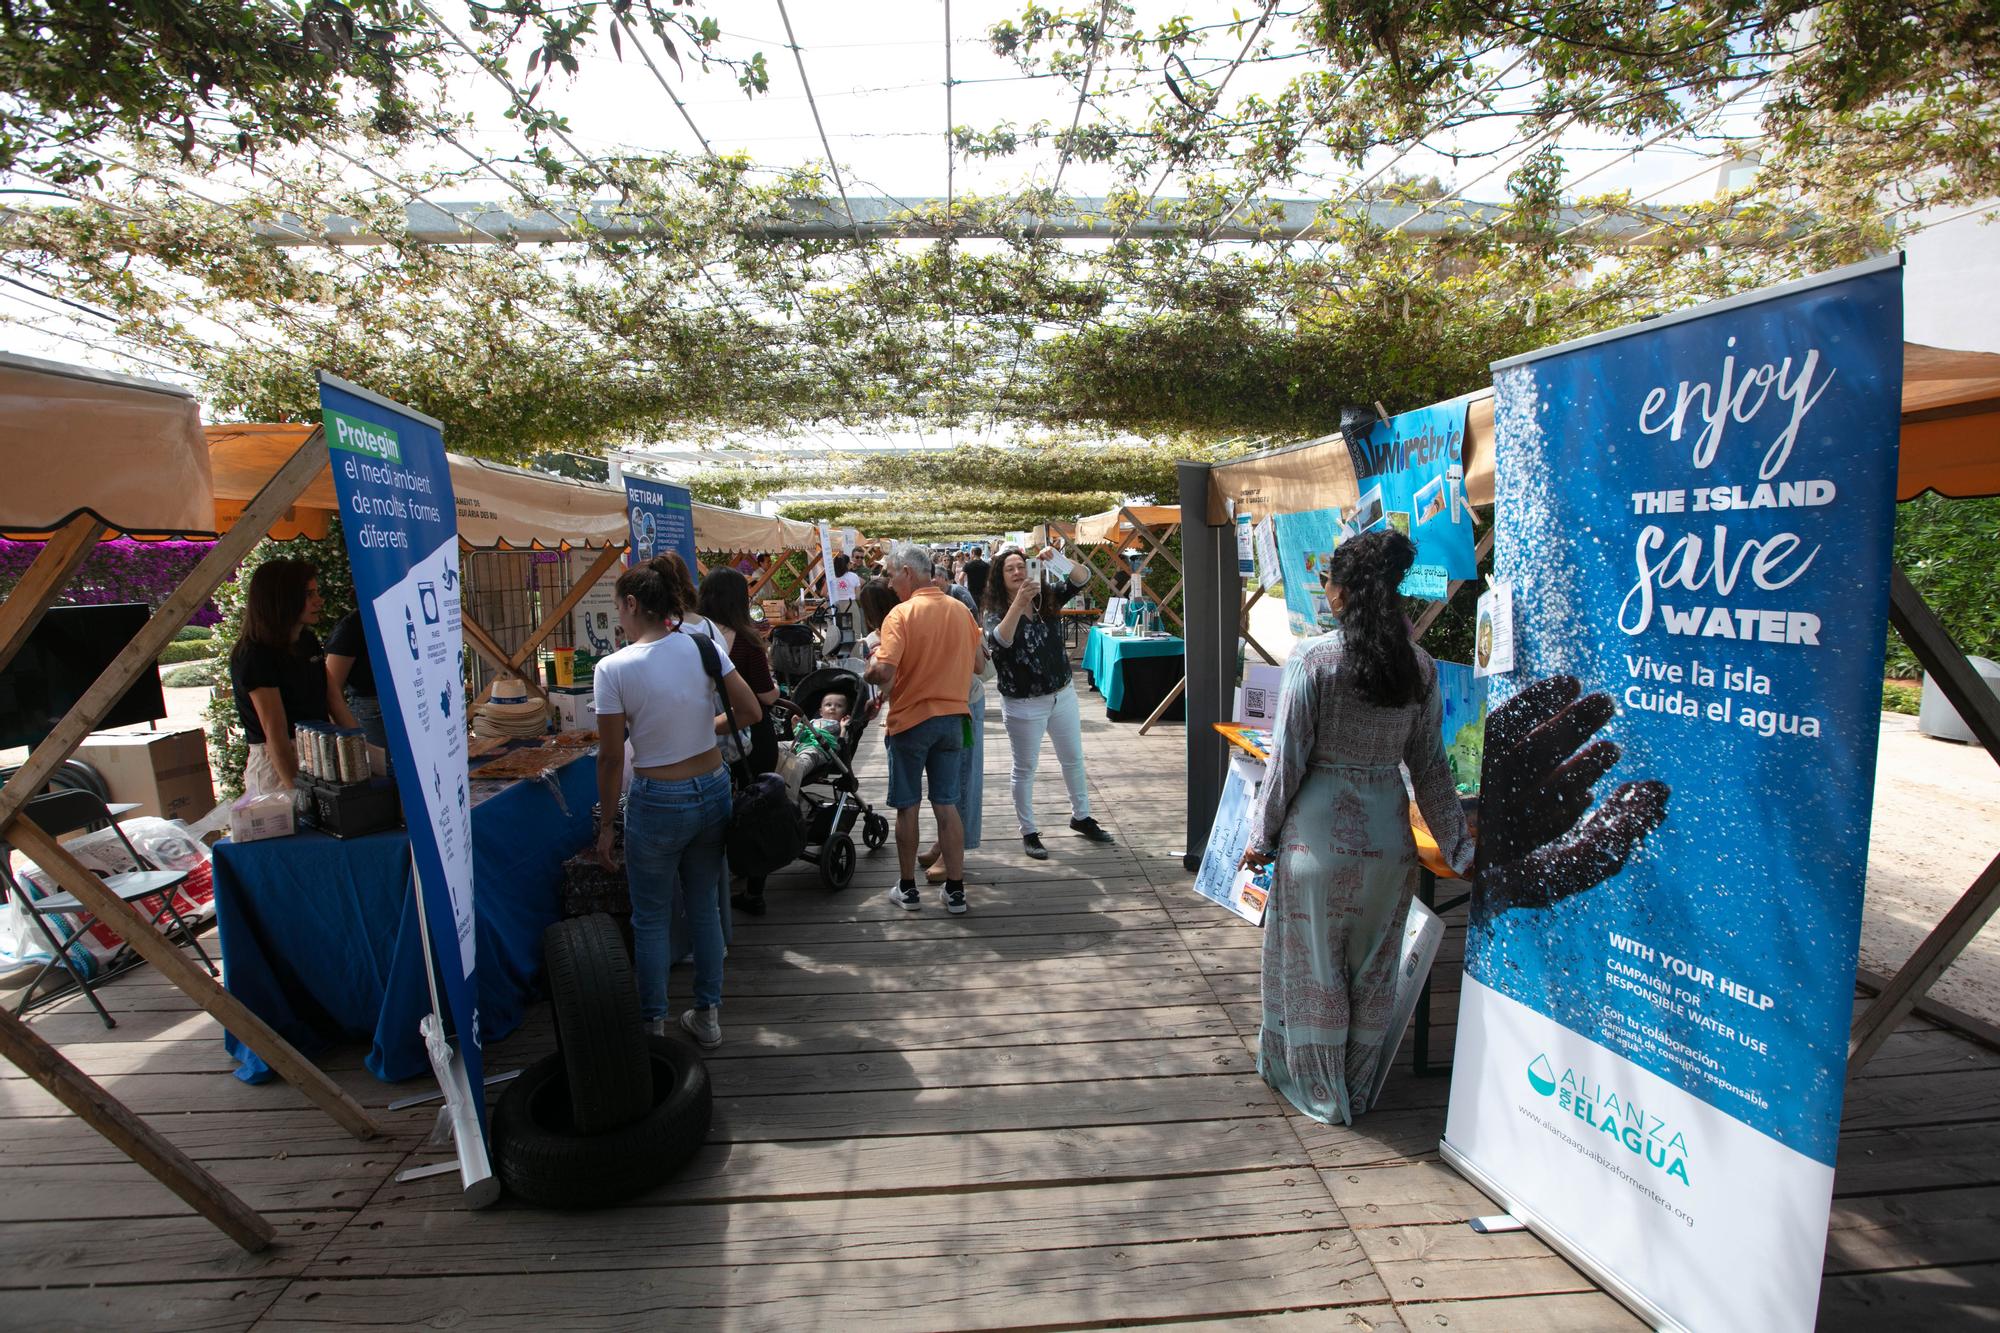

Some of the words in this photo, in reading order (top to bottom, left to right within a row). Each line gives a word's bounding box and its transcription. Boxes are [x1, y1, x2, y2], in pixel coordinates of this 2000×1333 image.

[1638, 337, 1837, 480] enjoy
[335, 417, 399, 459] Protegim
[345, 456, 359, 480] el
[352, 490, 371, 514] de
[372, 495, 407, 519] moltes
[408, 498, 440, 522] formes
[628, 488, 664, 507] RETIRAM
[1631, 489, 1685, 515] THE
[1692, 479, 1836, 512] ISLAND
[360, 524, 408, 549] diferents
[1660, 605, 1822, 646] WATER
[1626, 655, 1683, 683] Vive
[1691, 660, 1715, 687] la
[1723, 665, 1770, 695] isla
[1624, 686, 1698, 717] Cuida
[1707, 697, 1731, 722] el
[1739, 708, 1820, 738] agua
[1607, 958, 1671, 995] CAMPAIGN
[1675, 987, 1700, 1007] FOR
[1609, 931, 1655, 962] WITH
[1659, 952, 1714, 989] YOUR
[1719, 977, 1774, 1011] HELP
[1605, 972, 1684, 1016] RESPONSIBLE
[1688, 1010, 1735, 1040] WATER
[1739, 1031, 1768, 1056] USE
[1601, 1028, 1615, 1040] del
[1616, 1035, 1639, 1053] agua
[1603, 1005, 1624, 1022] Con
[1627, 1016, 1639, 1030] tu
[1641, 1026, 1719, 1071] colaboración
[1602, 1018, 1642, 1044] Campaña
[1644, 1040, 1656, 1051] de
[1658, 1048, 1701, 1074] consumo
[1704, 1071, 1768, 1110] responsable
[1559, 1087, 1572, 1111] POR
[1561, 1068, 1688, 1158] ALIANZA
[1518, 1105, 1694, 1228] www.alianzaaguaibizaformentera.org
